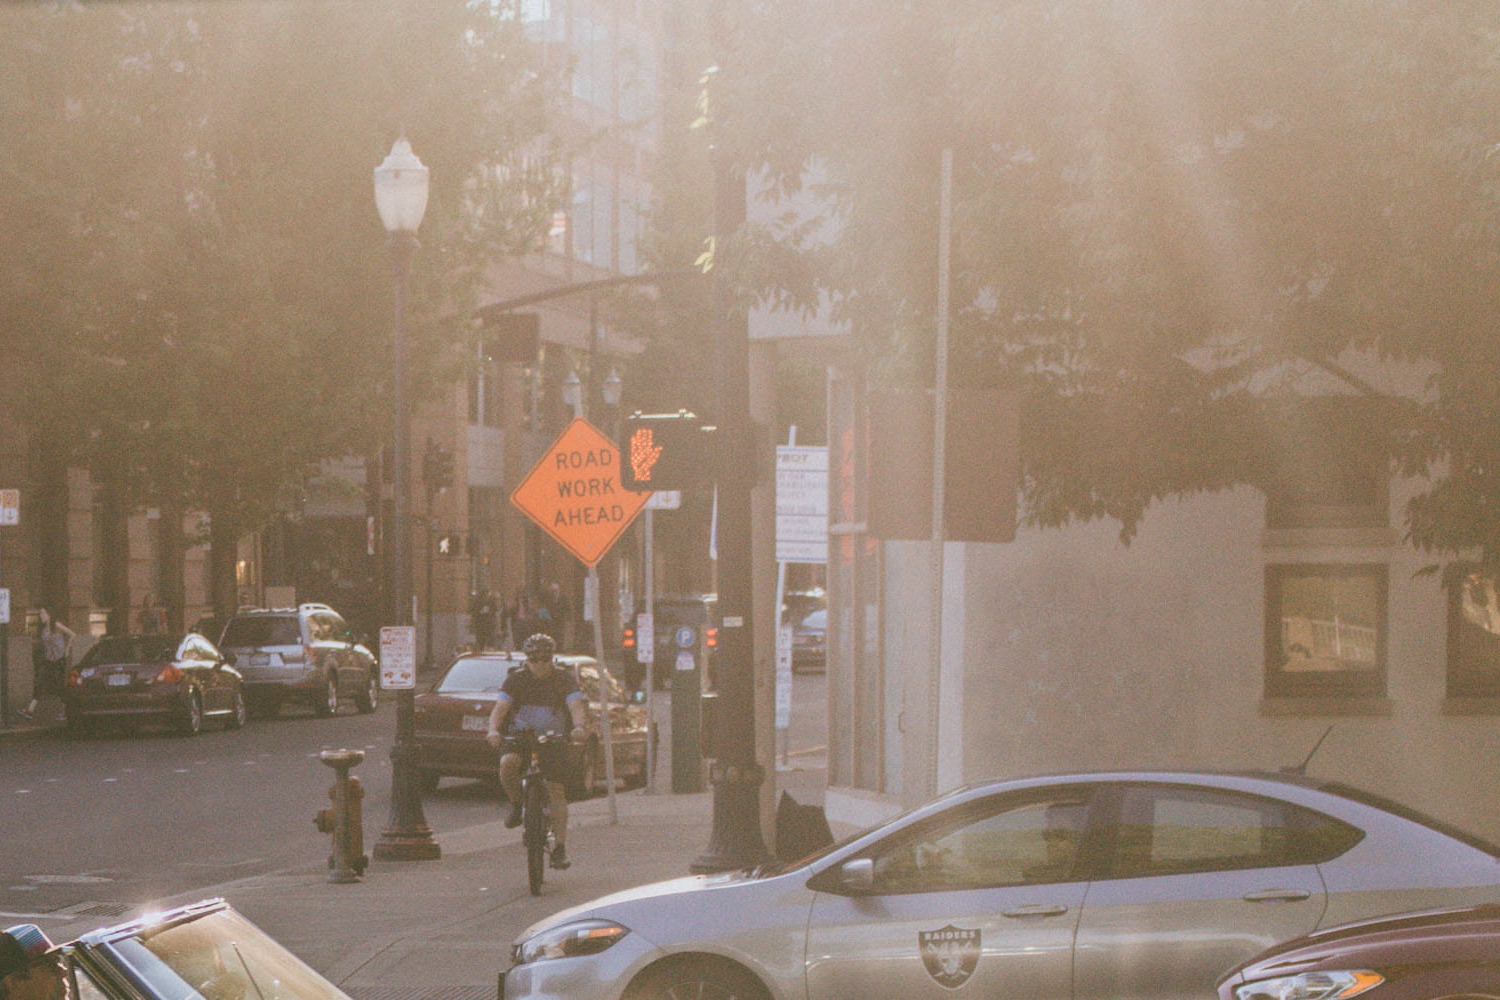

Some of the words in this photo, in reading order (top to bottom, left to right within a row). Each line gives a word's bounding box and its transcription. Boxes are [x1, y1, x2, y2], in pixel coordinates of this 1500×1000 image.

[555, 449, 612, 470] ROAD
[557, 477, 616, 498] WORK
[554, 504, 624, 527] AHEAD
[924, 931, 976, 941] RAIDERS
